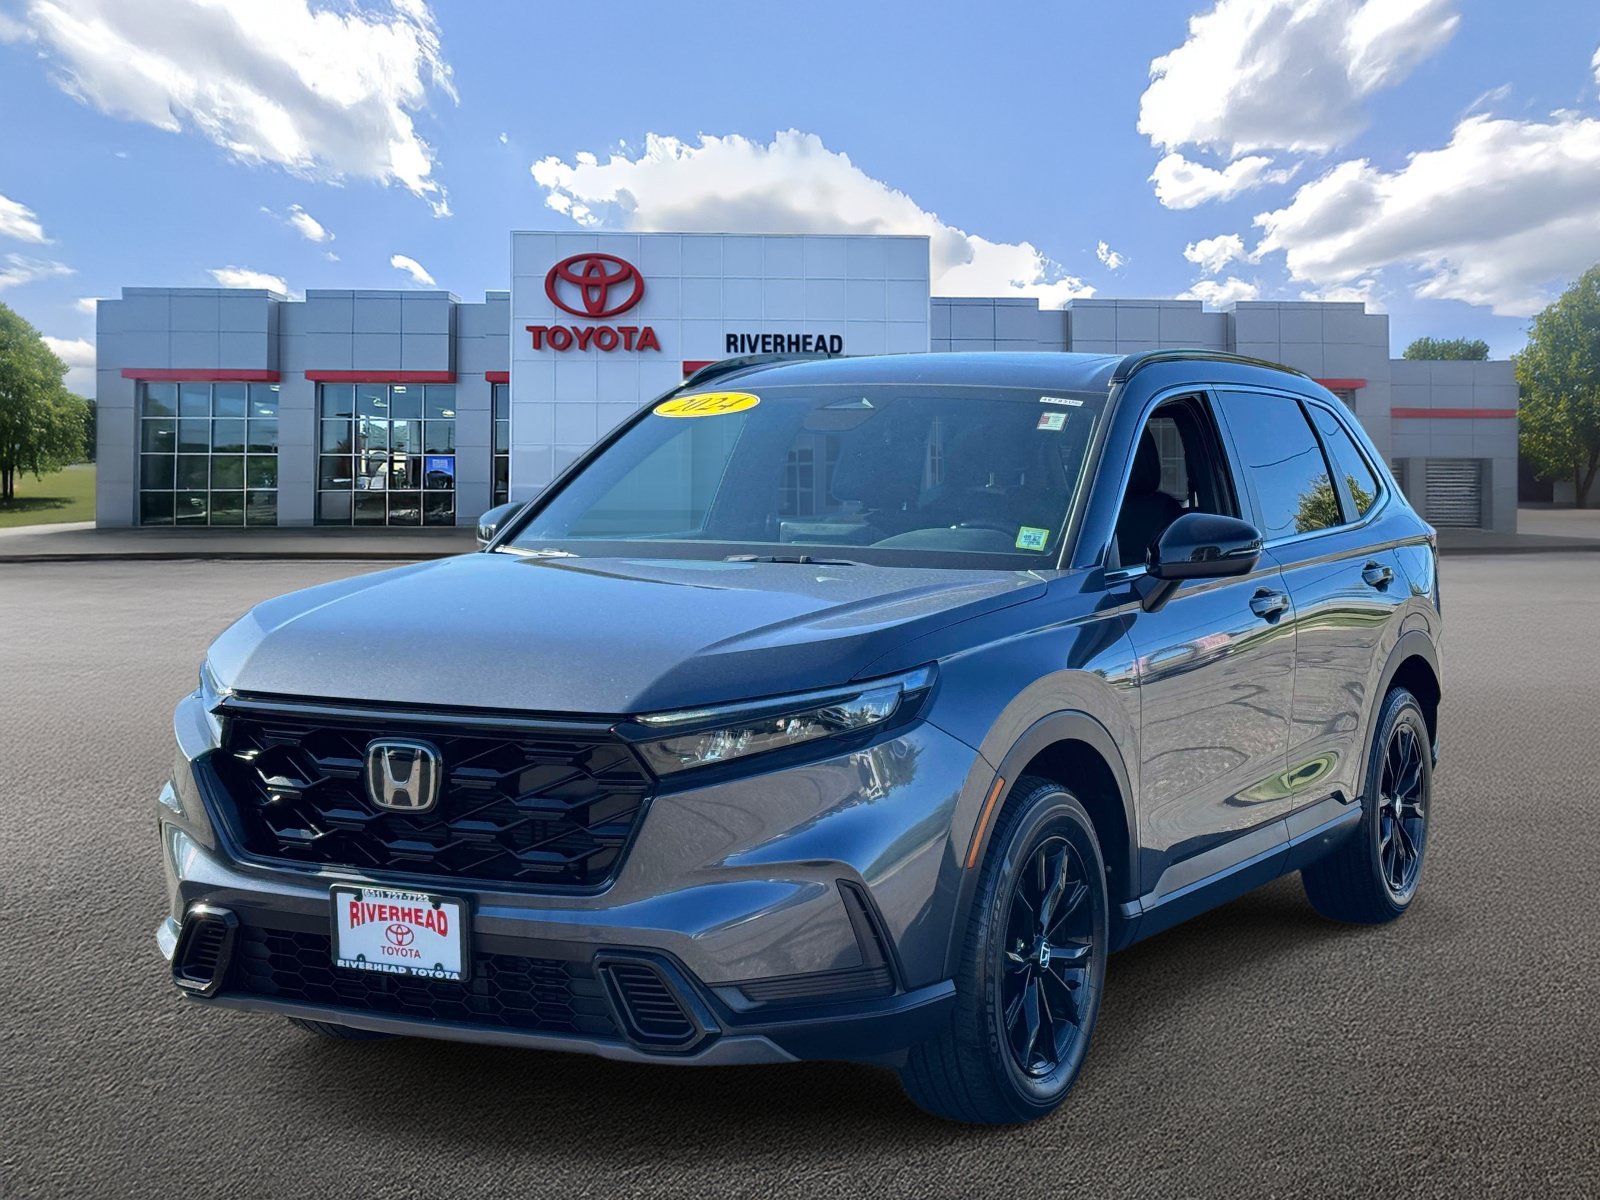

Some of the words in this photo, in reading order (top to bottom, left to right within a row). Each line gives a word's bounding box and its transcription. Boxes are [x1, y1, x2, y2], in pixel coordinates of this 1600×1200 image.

[526, 325, 661, 353] TOYOTA
[726, 333, 843, 354] RIVERHEAD
[663, 396, 751, 413] 2024
[349, 901, 448, 937] RIVERHEAD
[380, 945, 422, 959] TOYOTA
[336, 959, 407, 974] RIVERHEAD
[411, 967, 460, 980] TOYOTA
